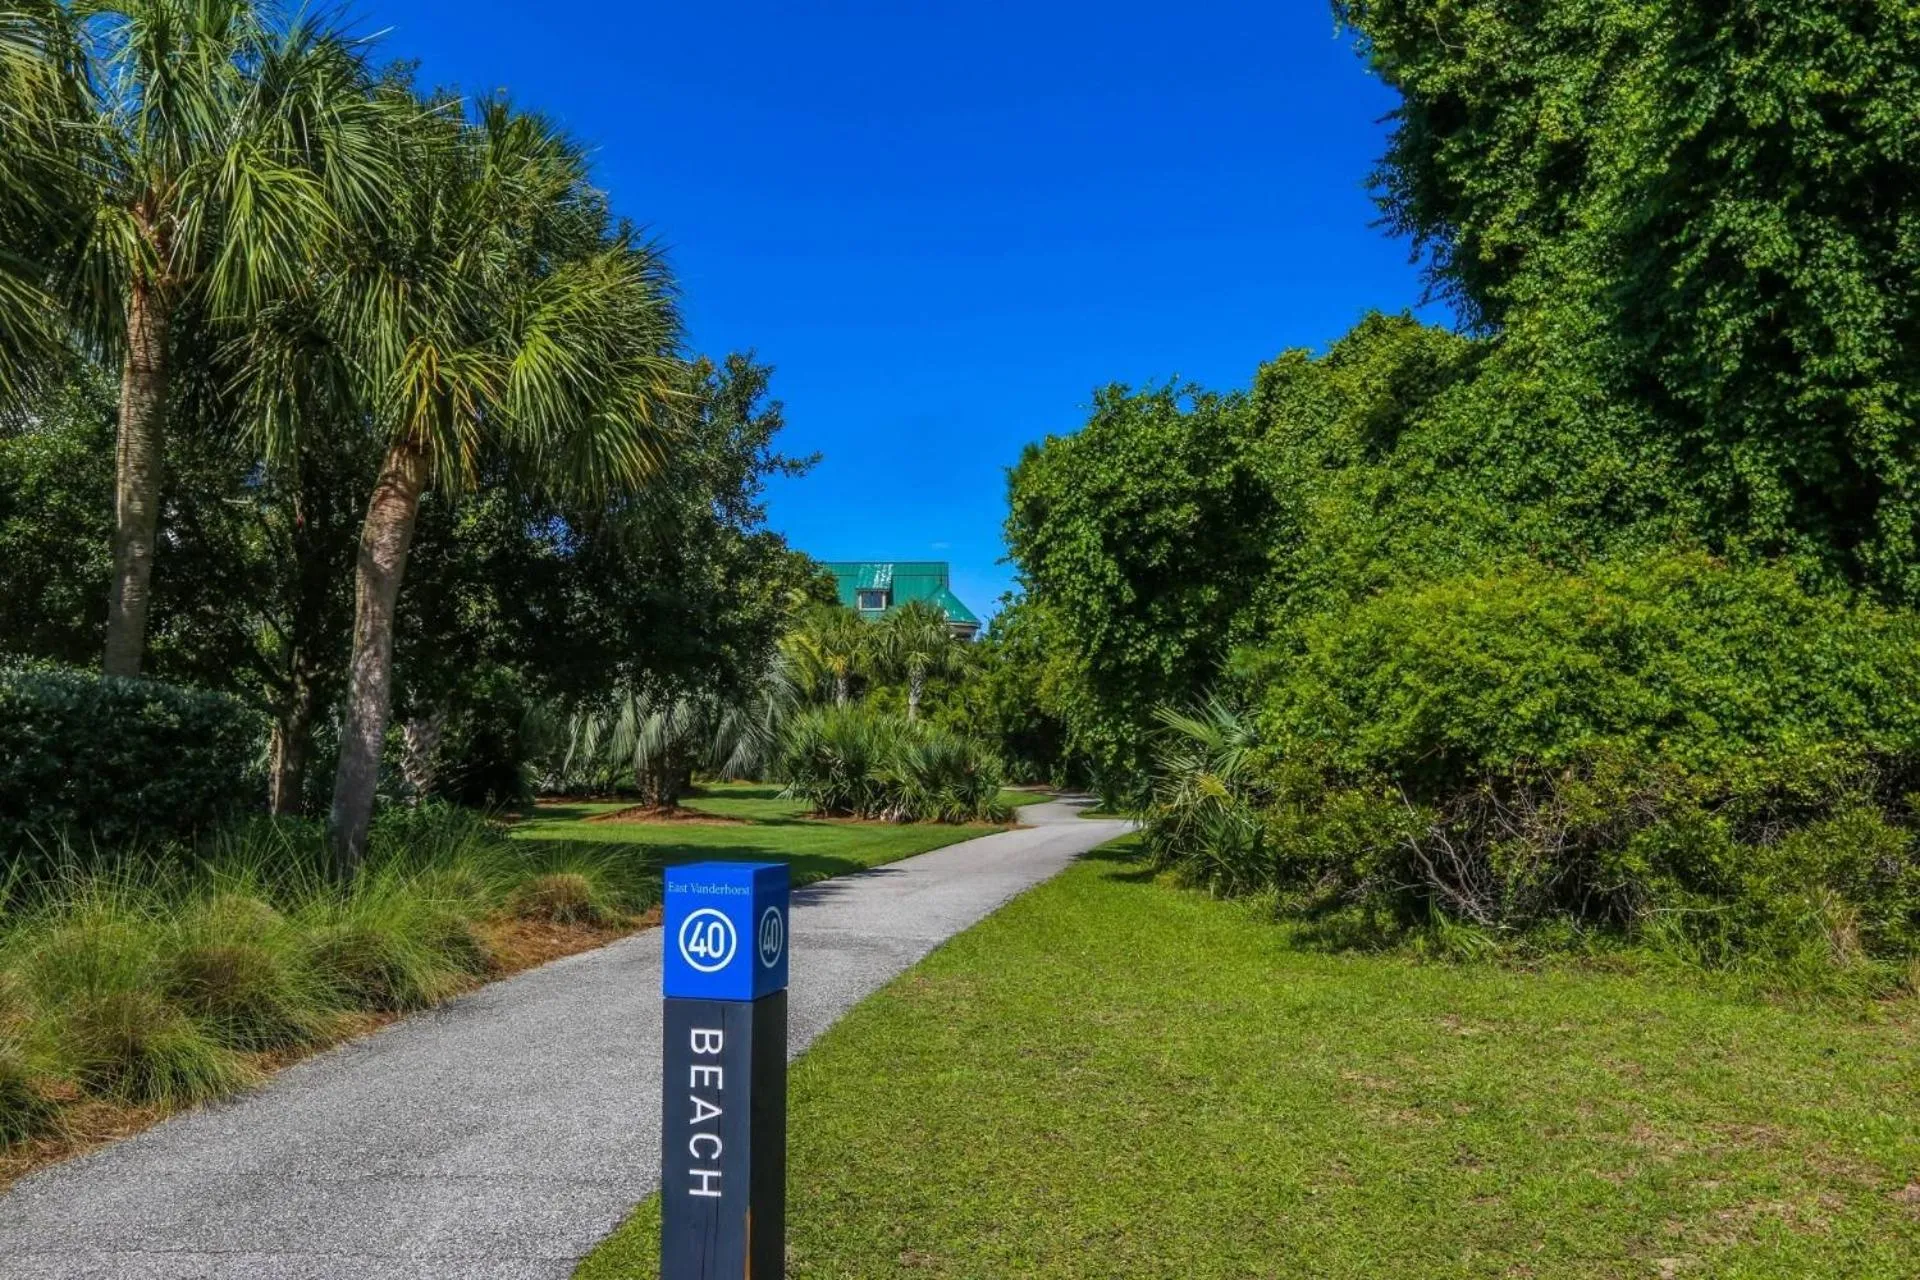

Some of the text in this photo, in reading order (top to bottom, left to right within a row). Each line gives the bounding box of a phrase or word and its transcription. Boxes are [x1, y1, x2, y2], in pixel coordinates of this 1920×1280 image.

[668, 881, 750, 895] East Vanderhorst
[688, 921, 725, 958] 40
[763, 918, 778, 954] 40
[689, 1028, 723, 1197] BEACH
